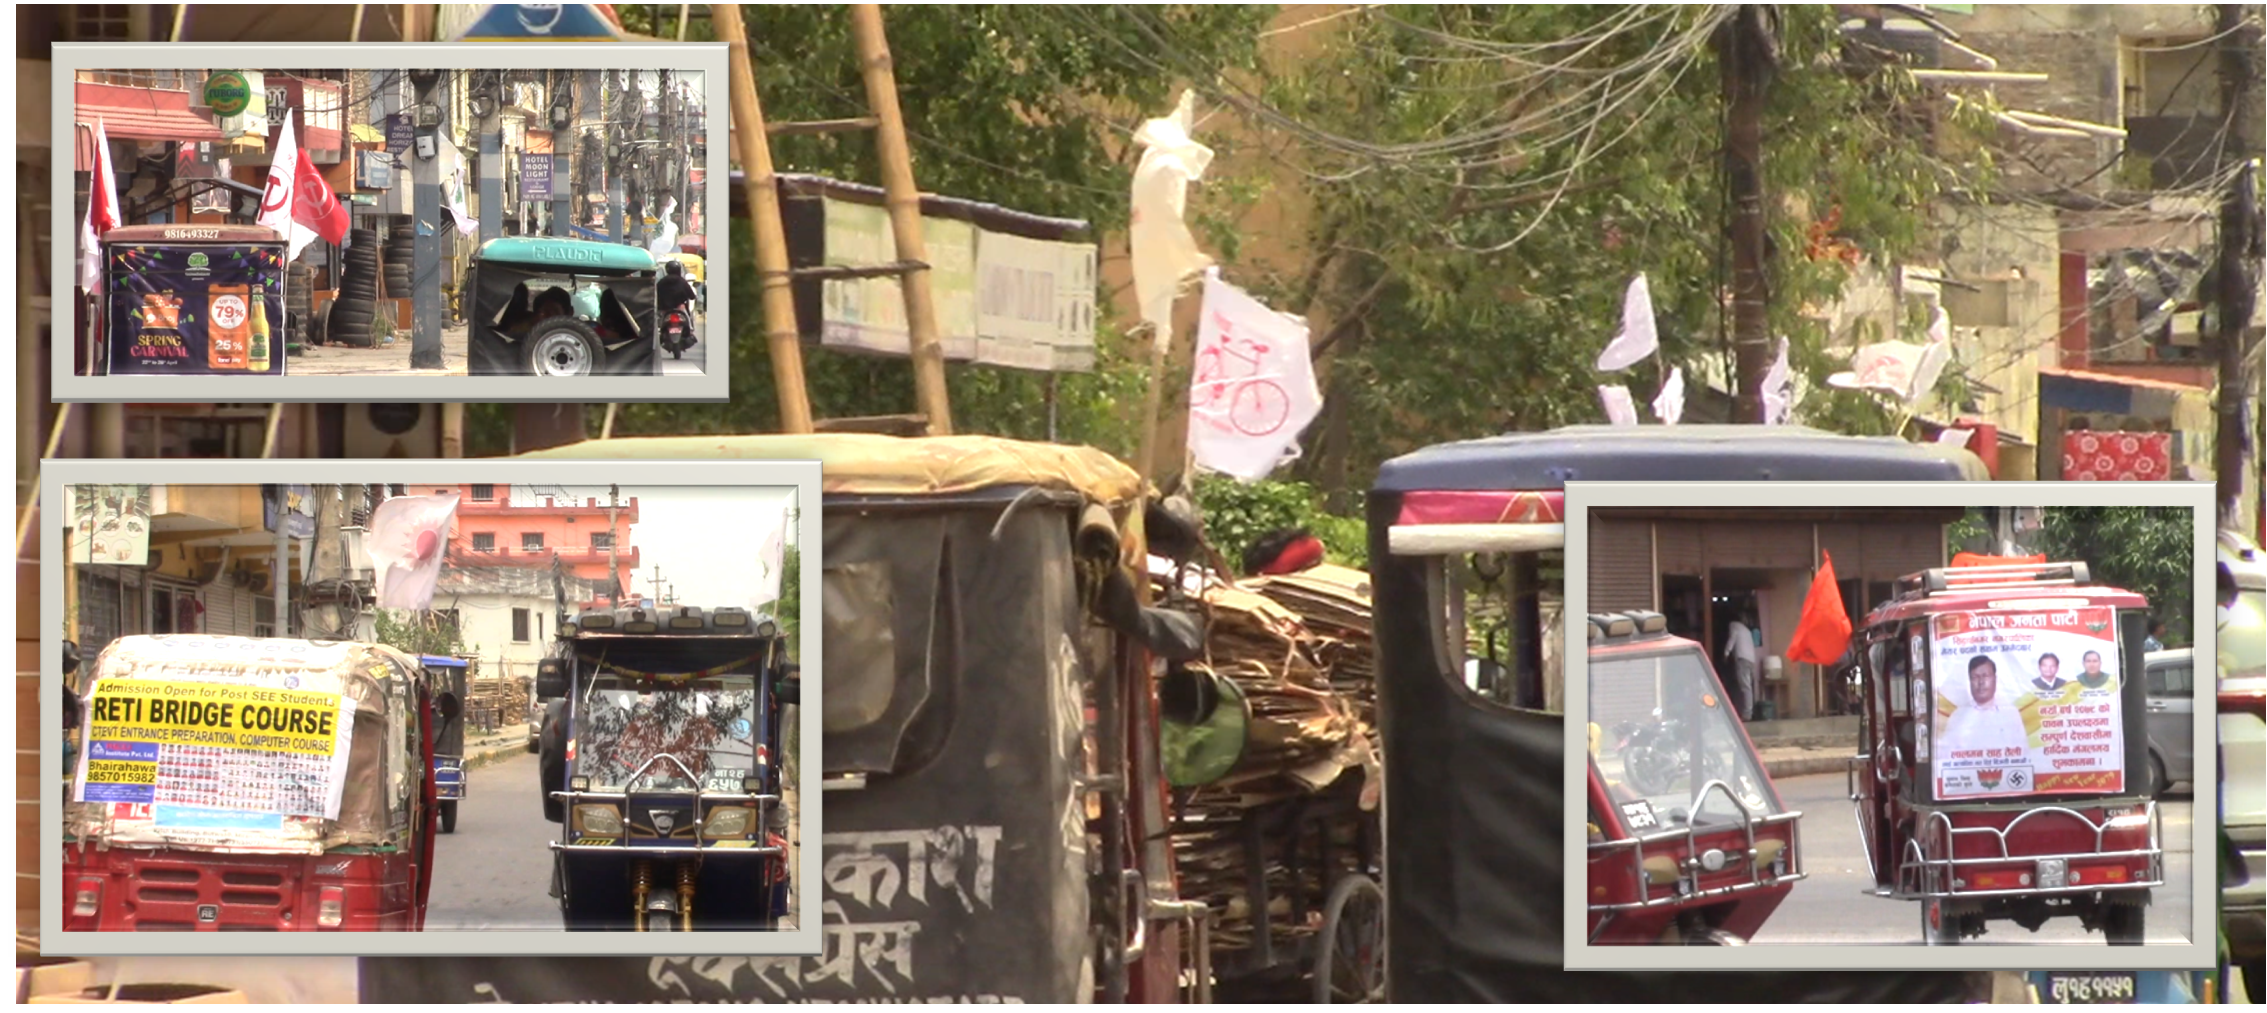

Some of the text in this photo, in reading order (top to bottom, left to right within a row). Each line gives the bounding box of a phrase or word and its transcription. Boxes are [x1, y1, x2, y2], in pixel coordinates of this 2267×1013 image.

[209, 88, 244, 98] TUBORG
[526, 170, 548, 178] LIGHT
[164, 229, 220, 239] 9816493327
[138, 334, 182, 346] SPRING
[130, 345, 190, 358] CARNIVAL
[2008, 614, 2047, 628] जनता
[98, 682, 160, 695] Admission
[164, 685, 196, 697] Open
[200, 687, 216, 698] for
[220, 688, 248, 700] Post
[252, 691, 277, 702] SEE
[94, 697, 333, 736] RETI BRIDGE COURSE
[92, 726, 119, 738] CTEVT
[120, 726, 170, 740] ENTRANCE
[240, 734, 290, 749] COMPUTER
[292, 738, 330, 752] COURSE
[89, 761, 156, 772] Bhairahawa
[87, 772, 156, 783] 9857015982
[201, 909, 214, 919] RE
